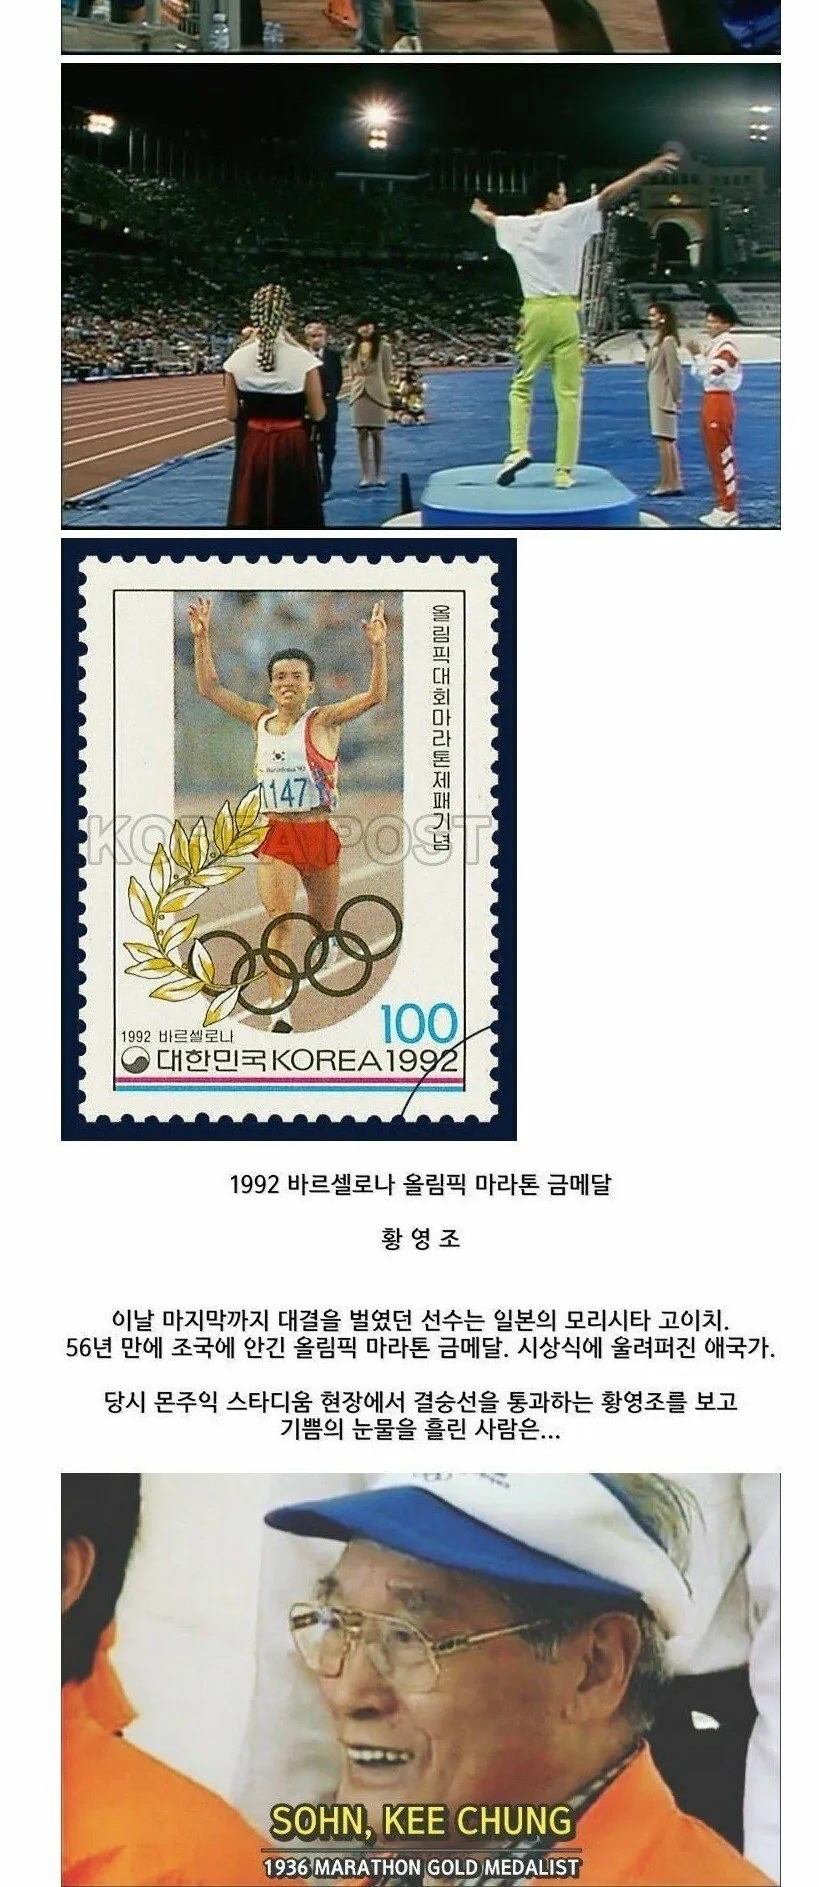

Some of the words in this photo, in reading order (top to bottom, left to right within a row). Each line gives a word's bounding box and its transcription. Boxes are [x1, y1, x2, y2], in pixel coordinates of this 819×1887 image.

[432, 604, 452, 852] 올림픽대회마라톤제패기념
[121, 1031, 151, 1044] 1992
[159, 1029, 235, 1044] 바르셀로나
[381, 1002, 458, 1045] 100
[157, 1049, 266, 1073] 대한민국
[273, 1050, 381, 1072] KOREA
[386, 1050, 459, 1073] 1992
